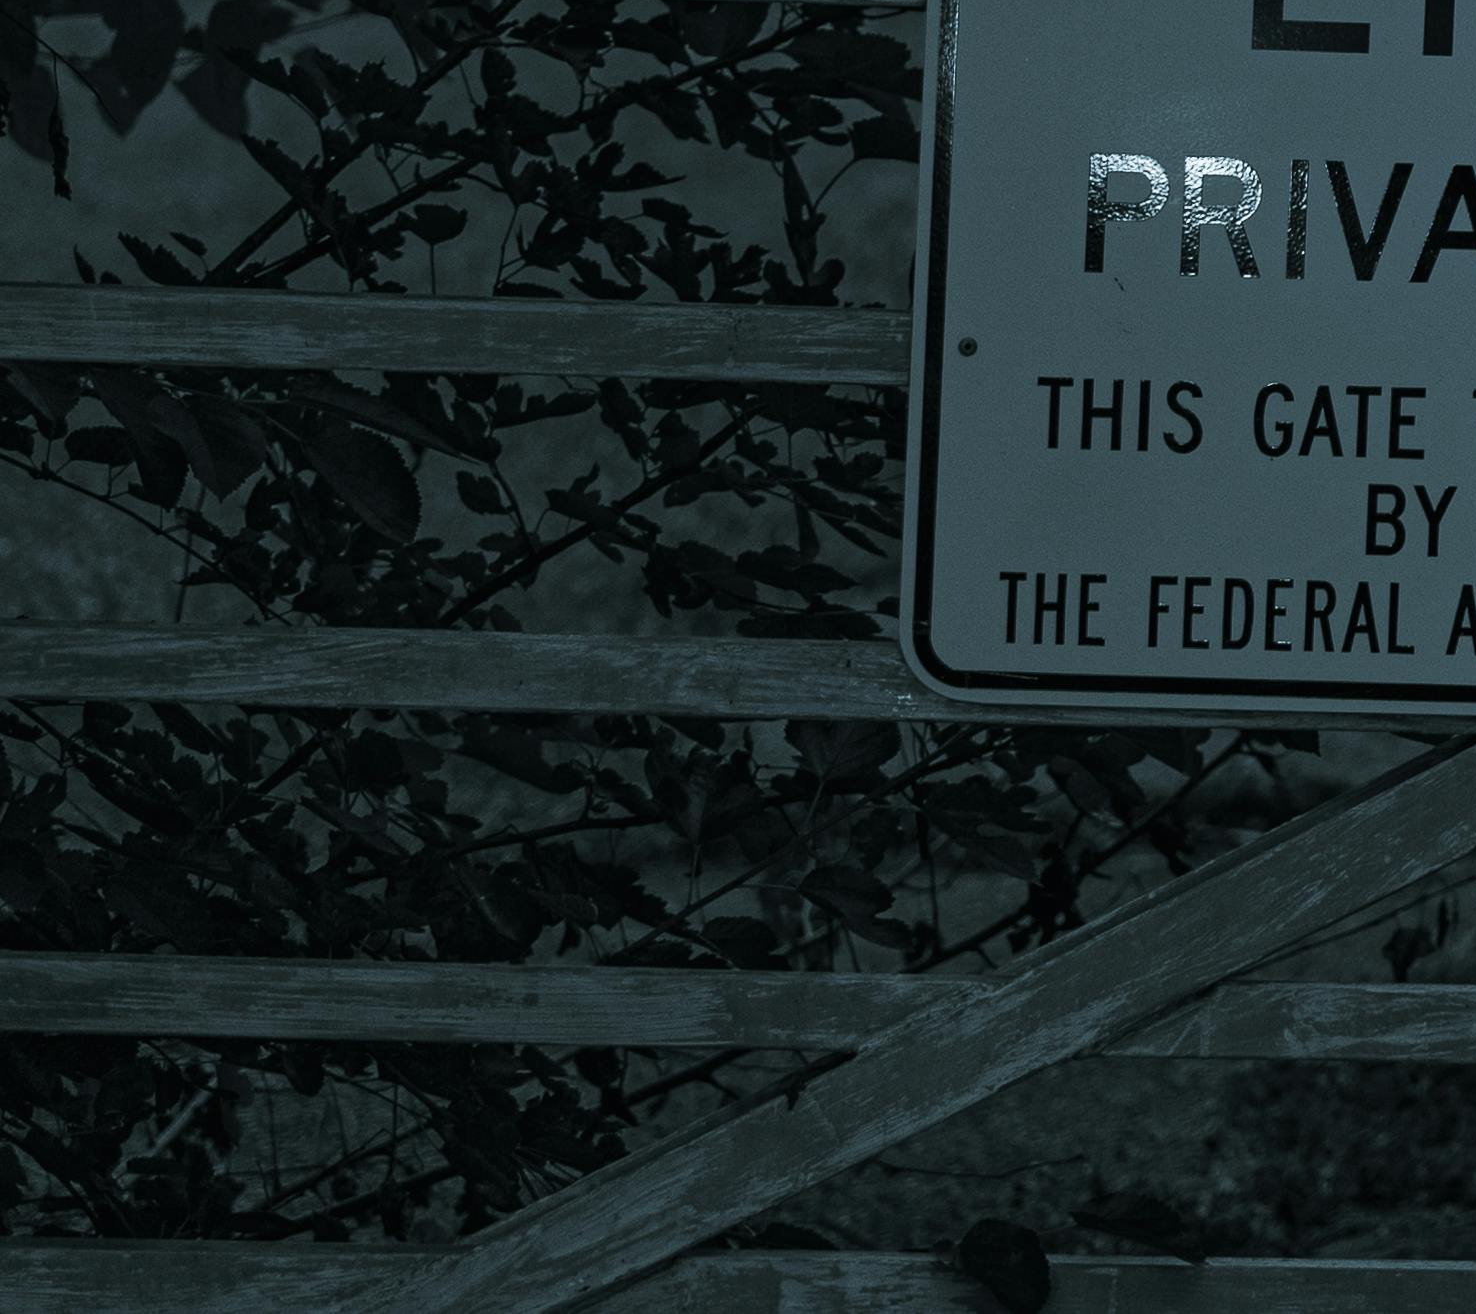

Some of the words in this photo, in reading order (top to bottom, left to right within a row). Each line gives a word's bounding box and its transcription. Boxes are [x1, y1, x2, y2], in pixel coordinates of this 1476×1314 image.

[1036, 376, 1205, 452] THIS
[1252, 382, 1427, 462] GATE
[1365, 483, 1457, 558] BY
[998, 571, 1107, 648] THE
[1147, 577, 1415, 655] FEDERAL
